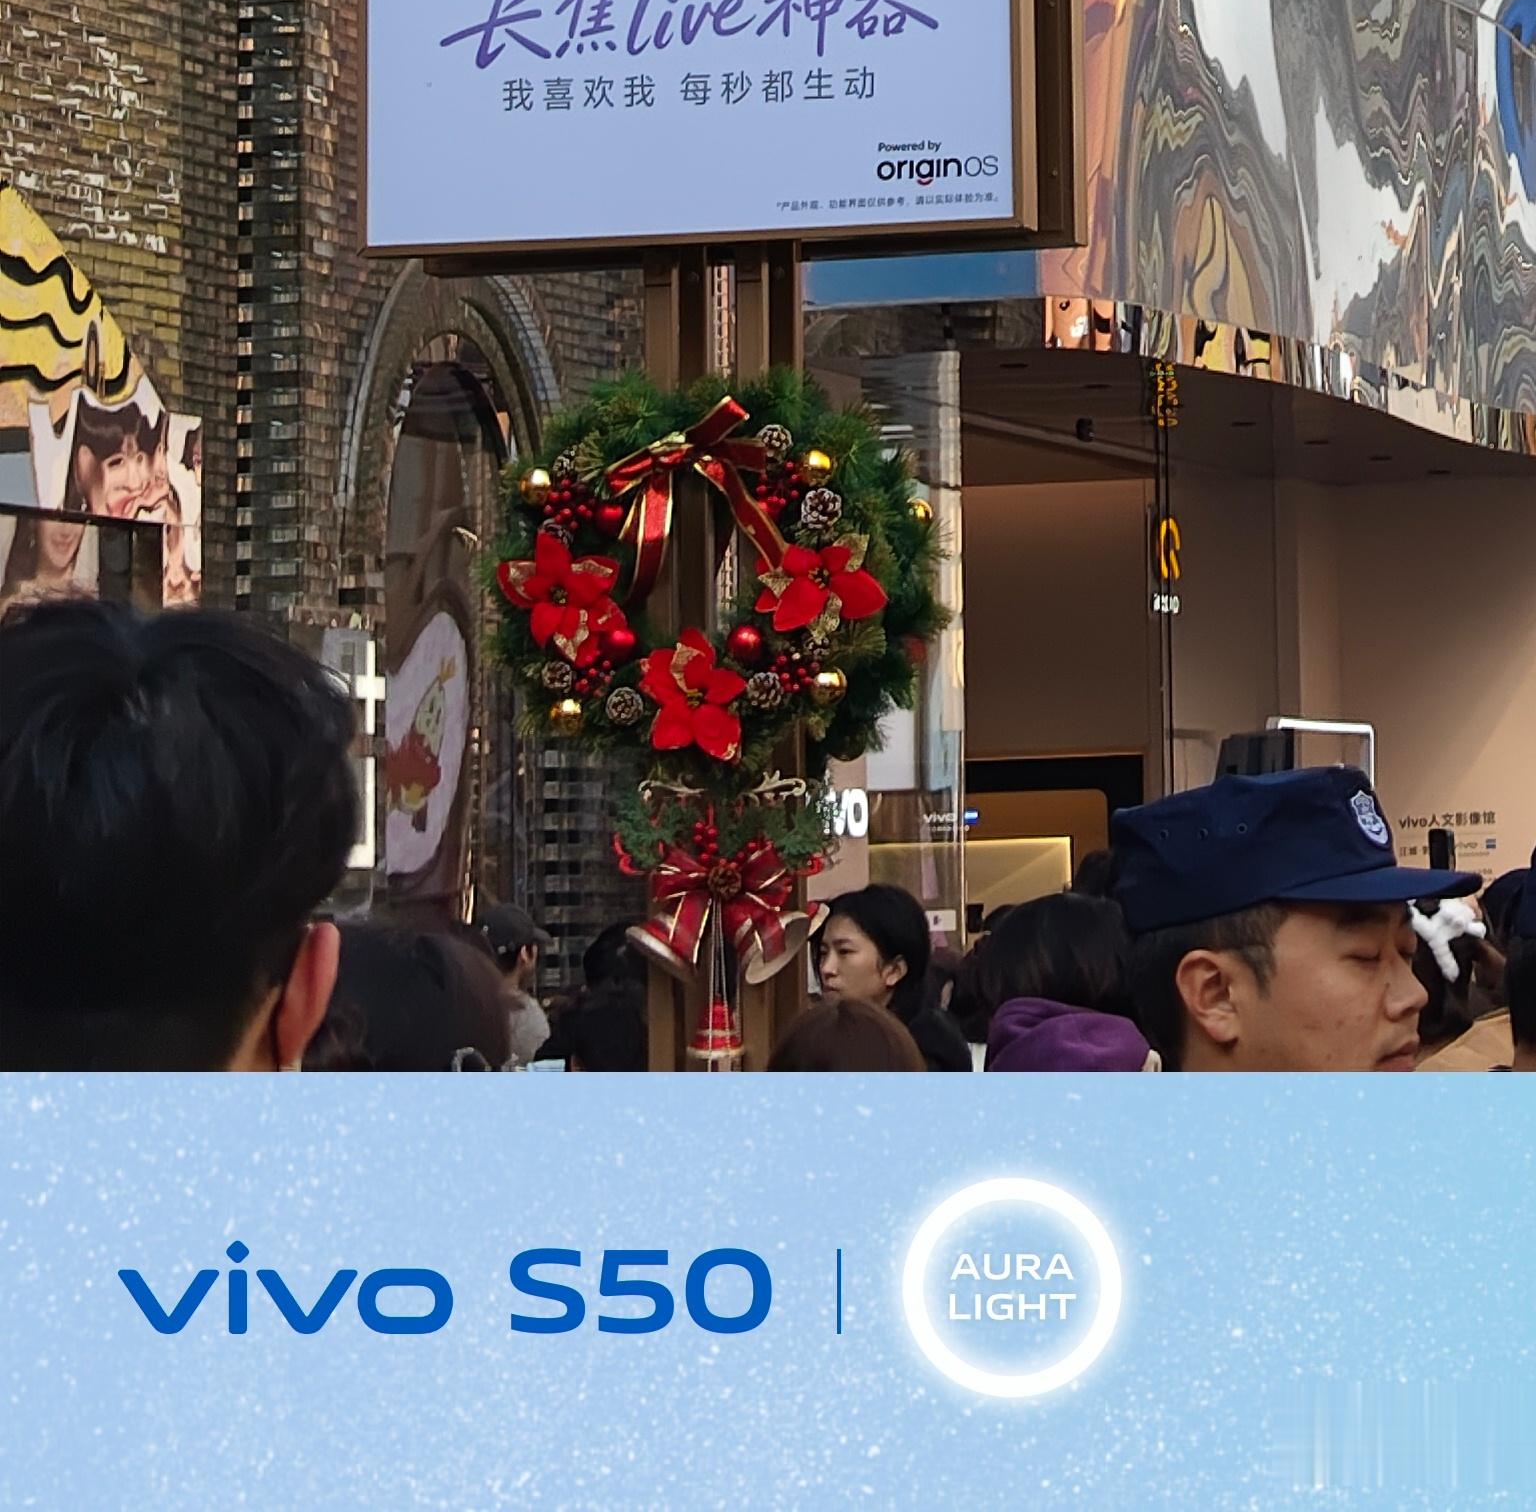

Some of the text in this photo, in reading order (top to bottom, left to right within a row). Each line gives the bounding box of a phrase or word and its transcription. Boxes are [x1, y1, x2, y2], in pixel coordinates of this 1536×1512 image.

[502, 65, 876, 112] 我喜欢我 每秒都生动
[877, 139, 942, 153] Powered by
[876, 154, 999, 186] originOS
[1398, 810, 1496, 829] vivo人文影像馆
